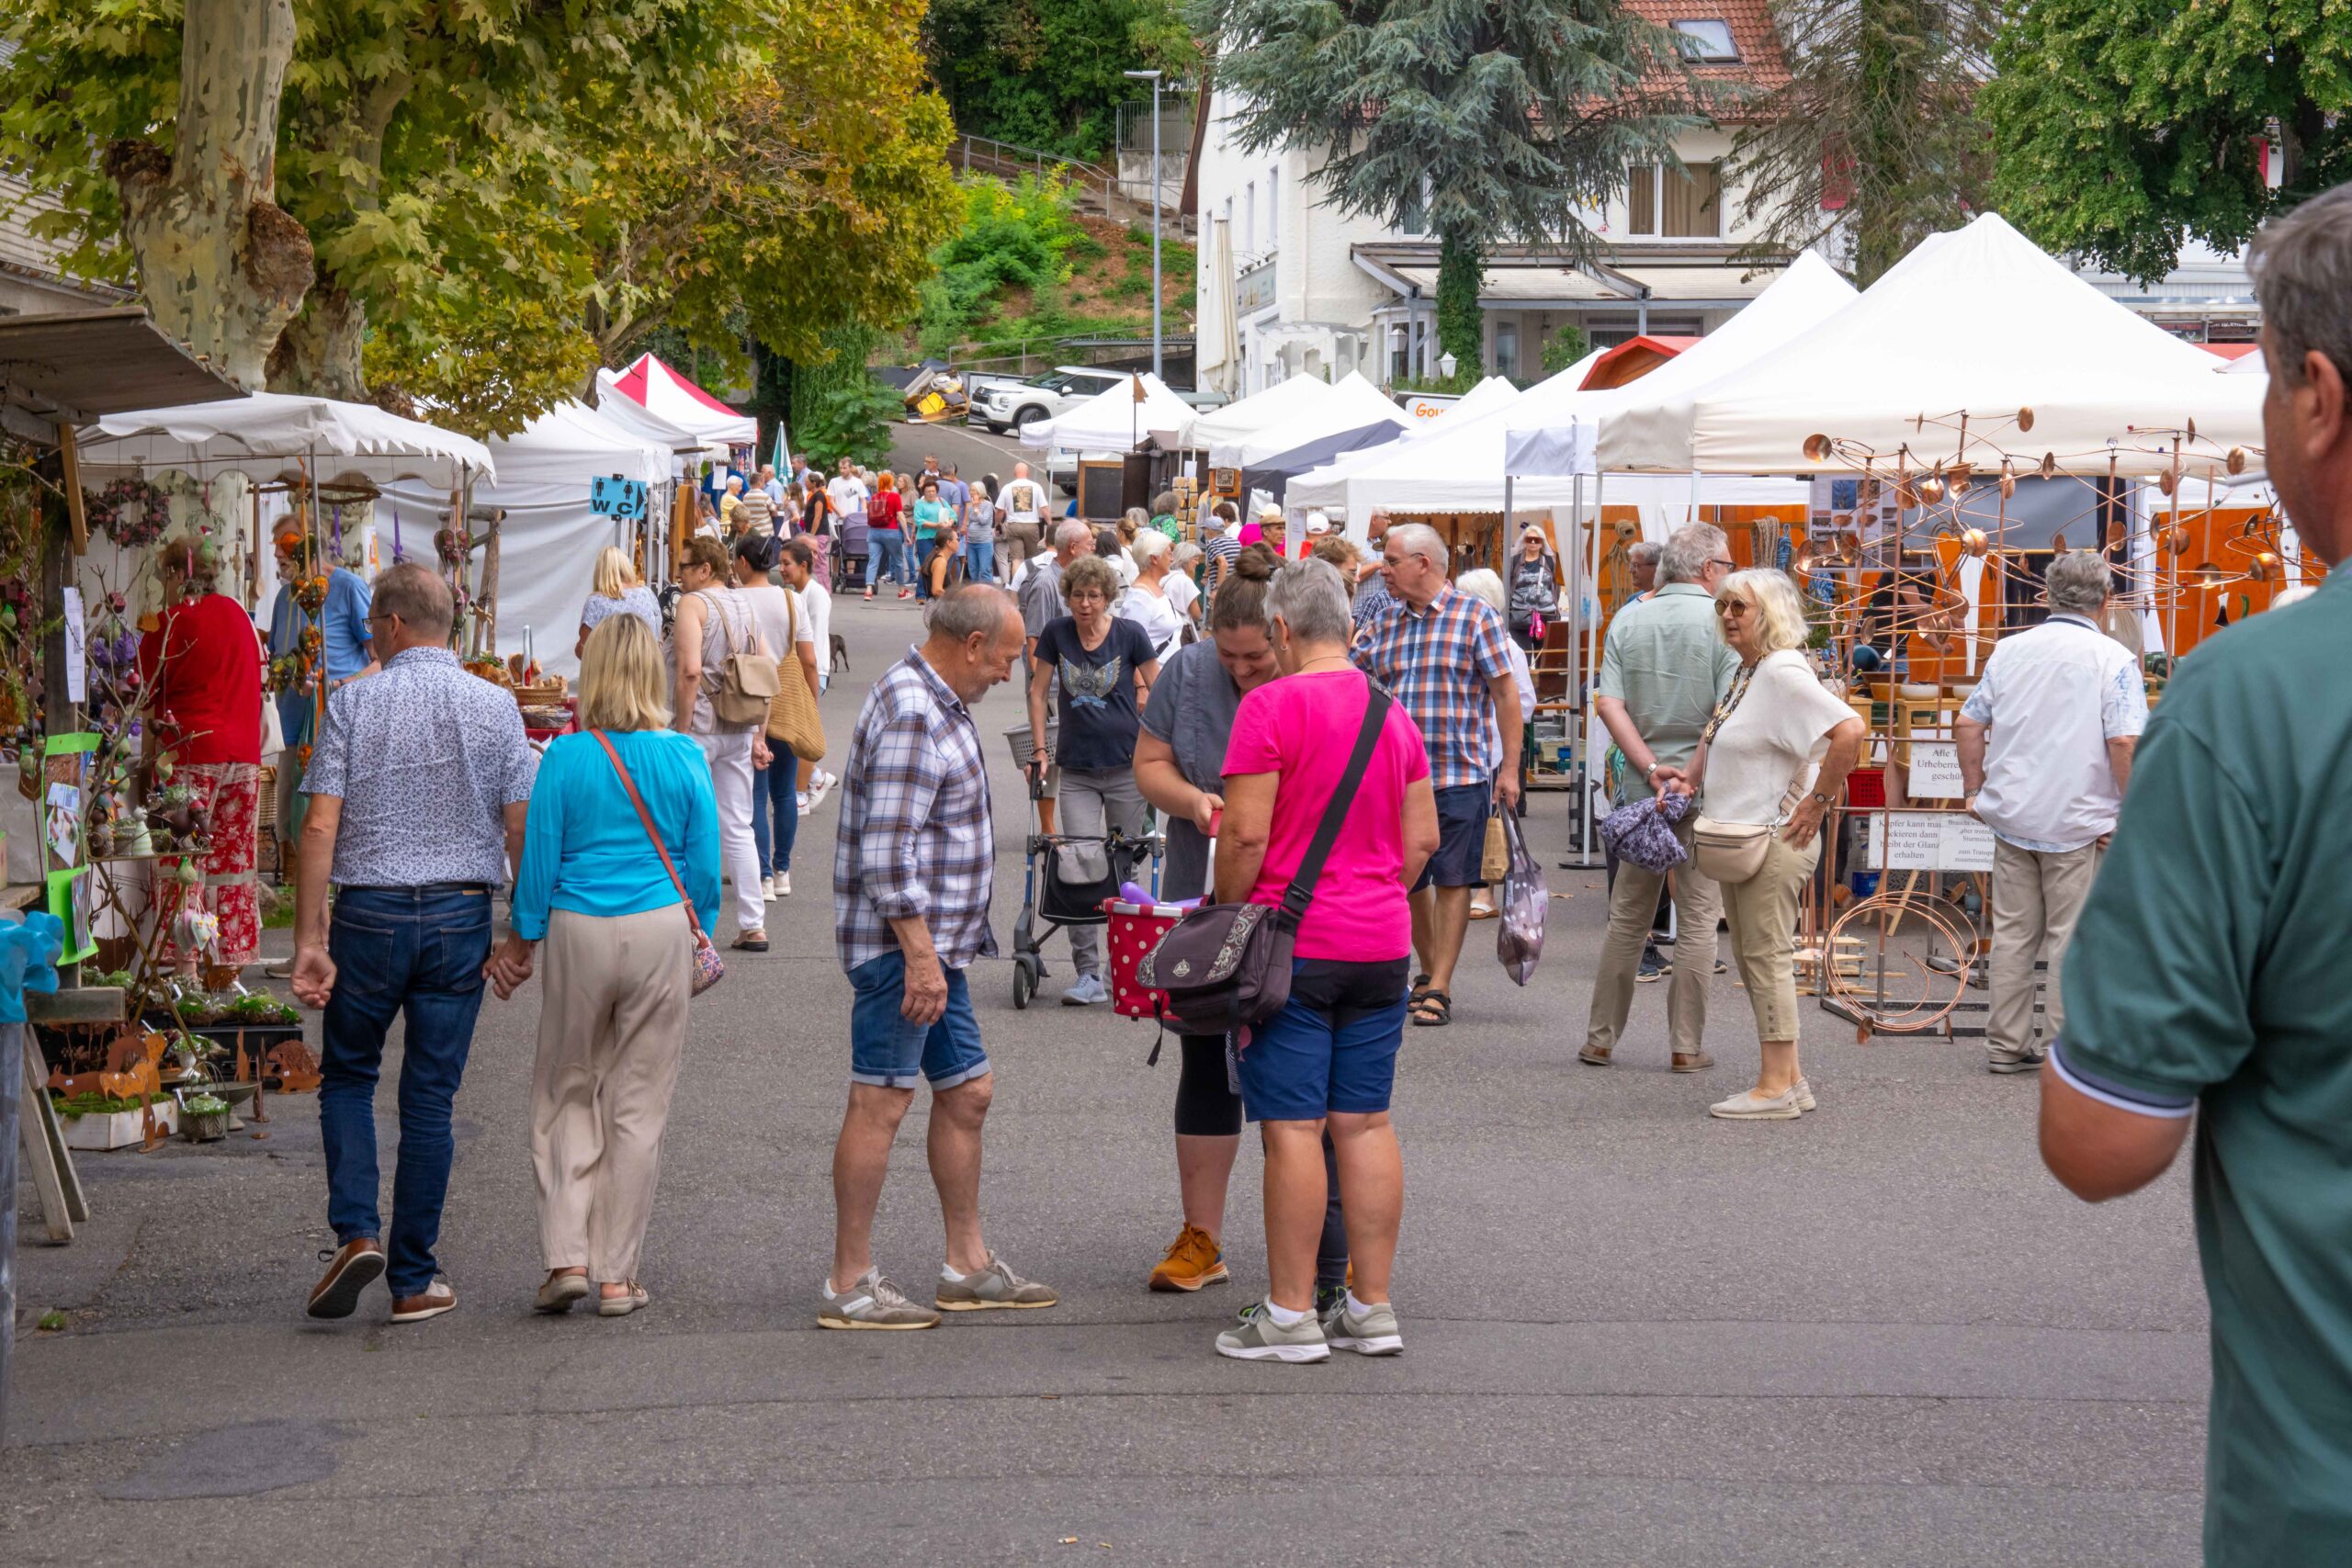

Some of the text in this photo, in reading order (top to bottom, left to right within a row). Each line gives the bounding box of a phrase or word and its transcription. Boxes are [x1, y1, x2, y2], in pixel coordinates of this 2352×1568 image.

[1932, 749, 1951, 757] Alle
[1917, 760, 1960, 769] Urheberre
[1879, 819, 1905, 829] Kpfer
[1906, 819, 1925, 828] kann
[1919, 830, 1938, 839] dann
[1903, 840, 1916, 849] der
[1894, 851, 1925, 860] erhalten
